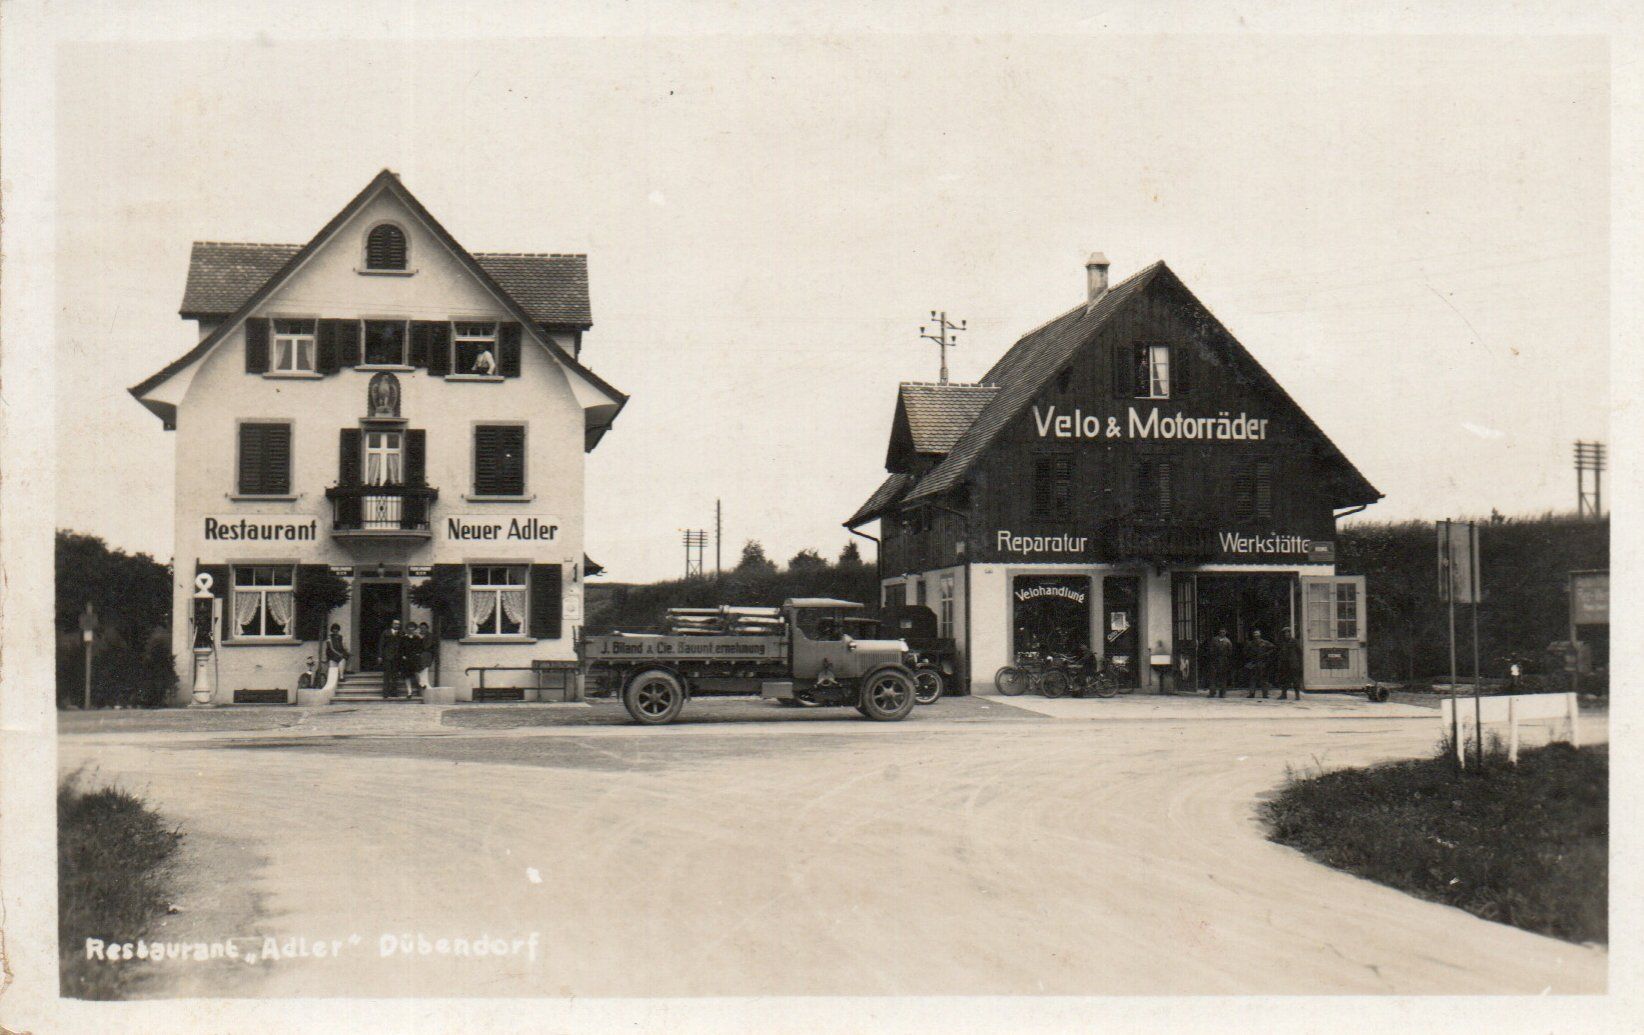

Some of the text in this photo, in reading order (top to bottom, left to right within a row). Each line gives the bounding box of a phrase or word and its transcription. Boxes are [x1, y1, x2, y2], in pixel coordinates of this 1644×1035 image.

[1032, 404, 1269, 440] Velo & Motorräder
[205, 518, 317, 541] Restaurant
[448, 518, 559, 541] Neuer Adler
[997, 530, 1088, 555] Reparatur
[1219, 531, 1311, 553] Werkstätte
[1015, 586, 1085, 604] Velohandlung
[600, 641, 610, 655] J.
